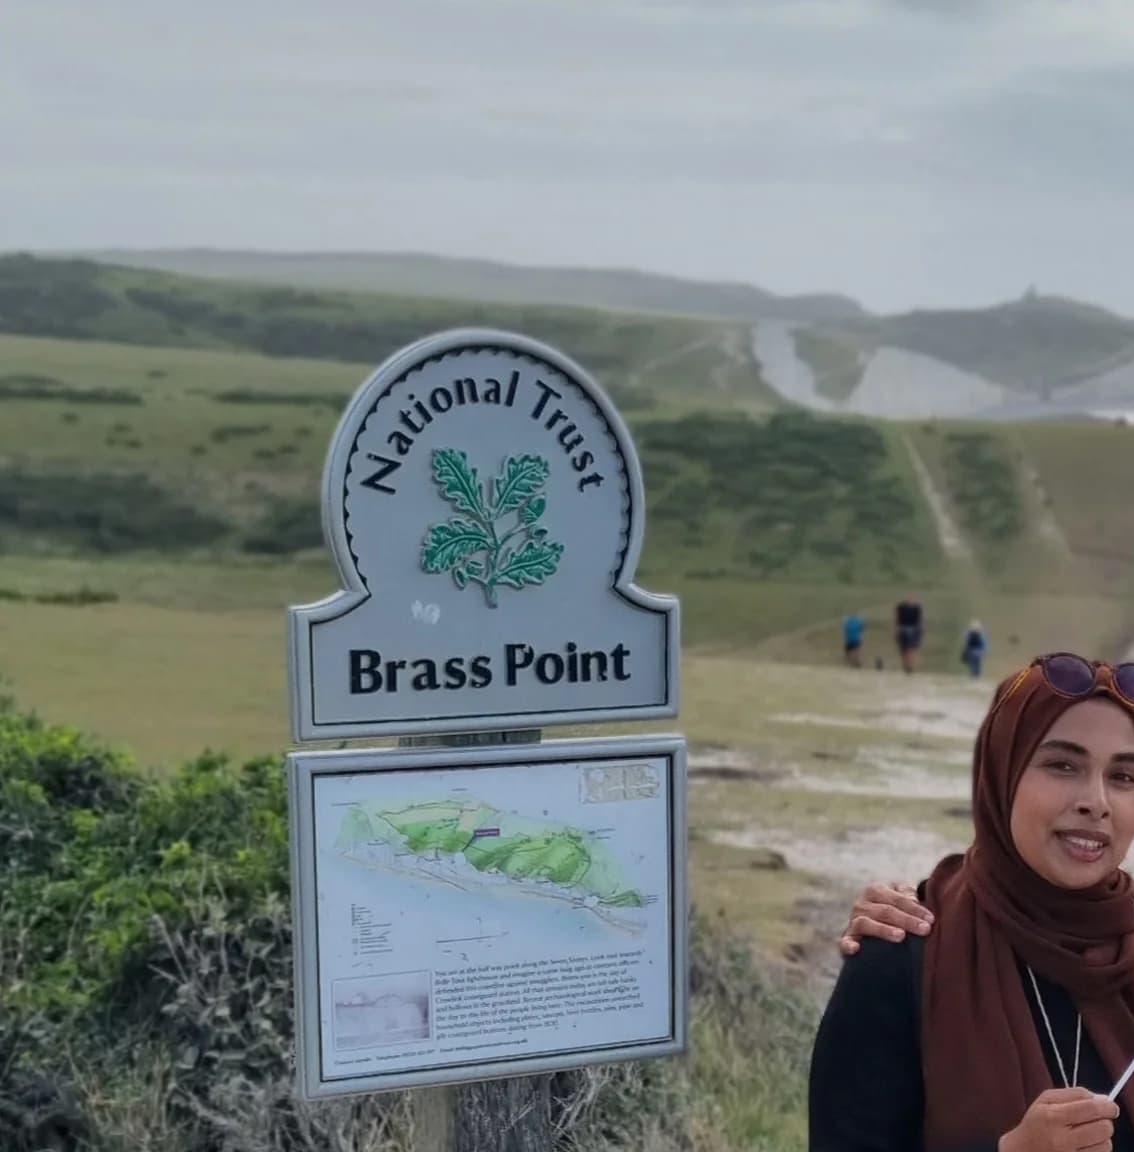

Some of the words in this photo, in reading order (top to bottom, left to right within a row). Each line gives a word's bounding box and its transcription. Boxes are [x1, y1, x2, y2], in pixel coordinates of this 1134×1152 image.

[360, 371, 520, 495] National
[531, 380, 605, 493] Trust
[349, 649, 492, 694] Brass
[504, 642, 631, 686] Point
